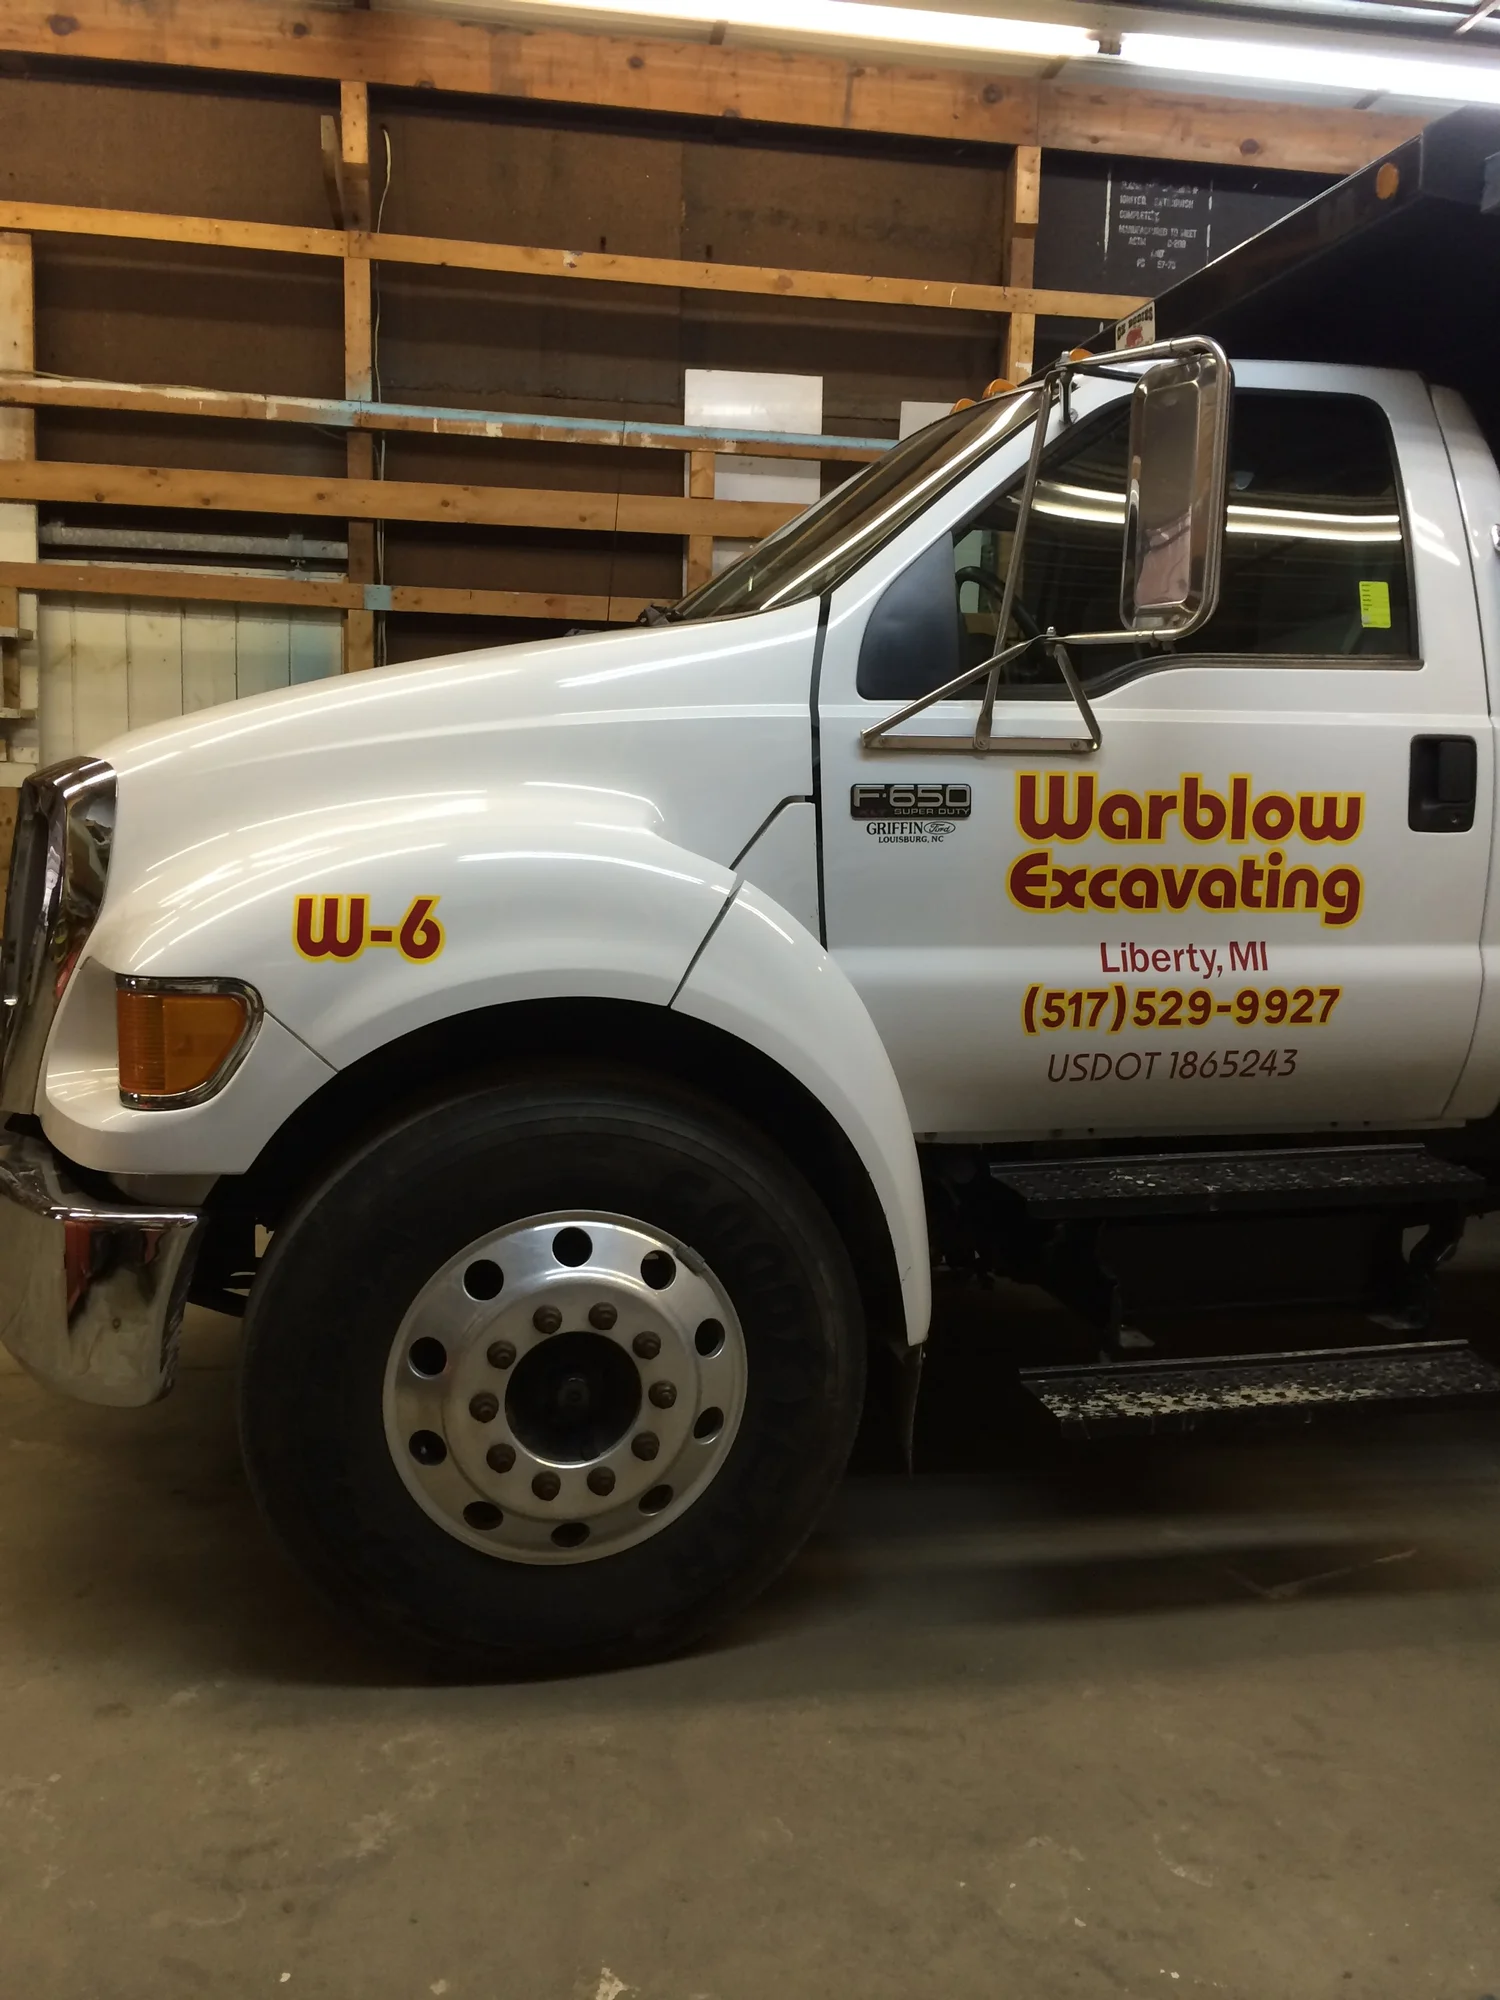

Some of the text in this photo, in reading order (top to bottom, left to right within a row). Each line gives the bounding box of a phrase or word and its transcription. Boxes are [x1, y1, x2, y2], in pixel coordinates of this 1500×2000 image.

[893, 807, 934, 816] SUPER
[938, 807, 970, 816] DUTY
[1016, 771, 1365, 844] Warblow
[866, 821, 954, 836] GRIFFIN Ford
[878, 834, 945, 845] LOUISBURG, NC
[1007, 849, 1364, 927] Excavating
[293, 895, 445, 963] W-6
[1100, 940, 1268, 979] Liberty, MI
[1047, 1048, 1298, 1083] USDOT 1865243
